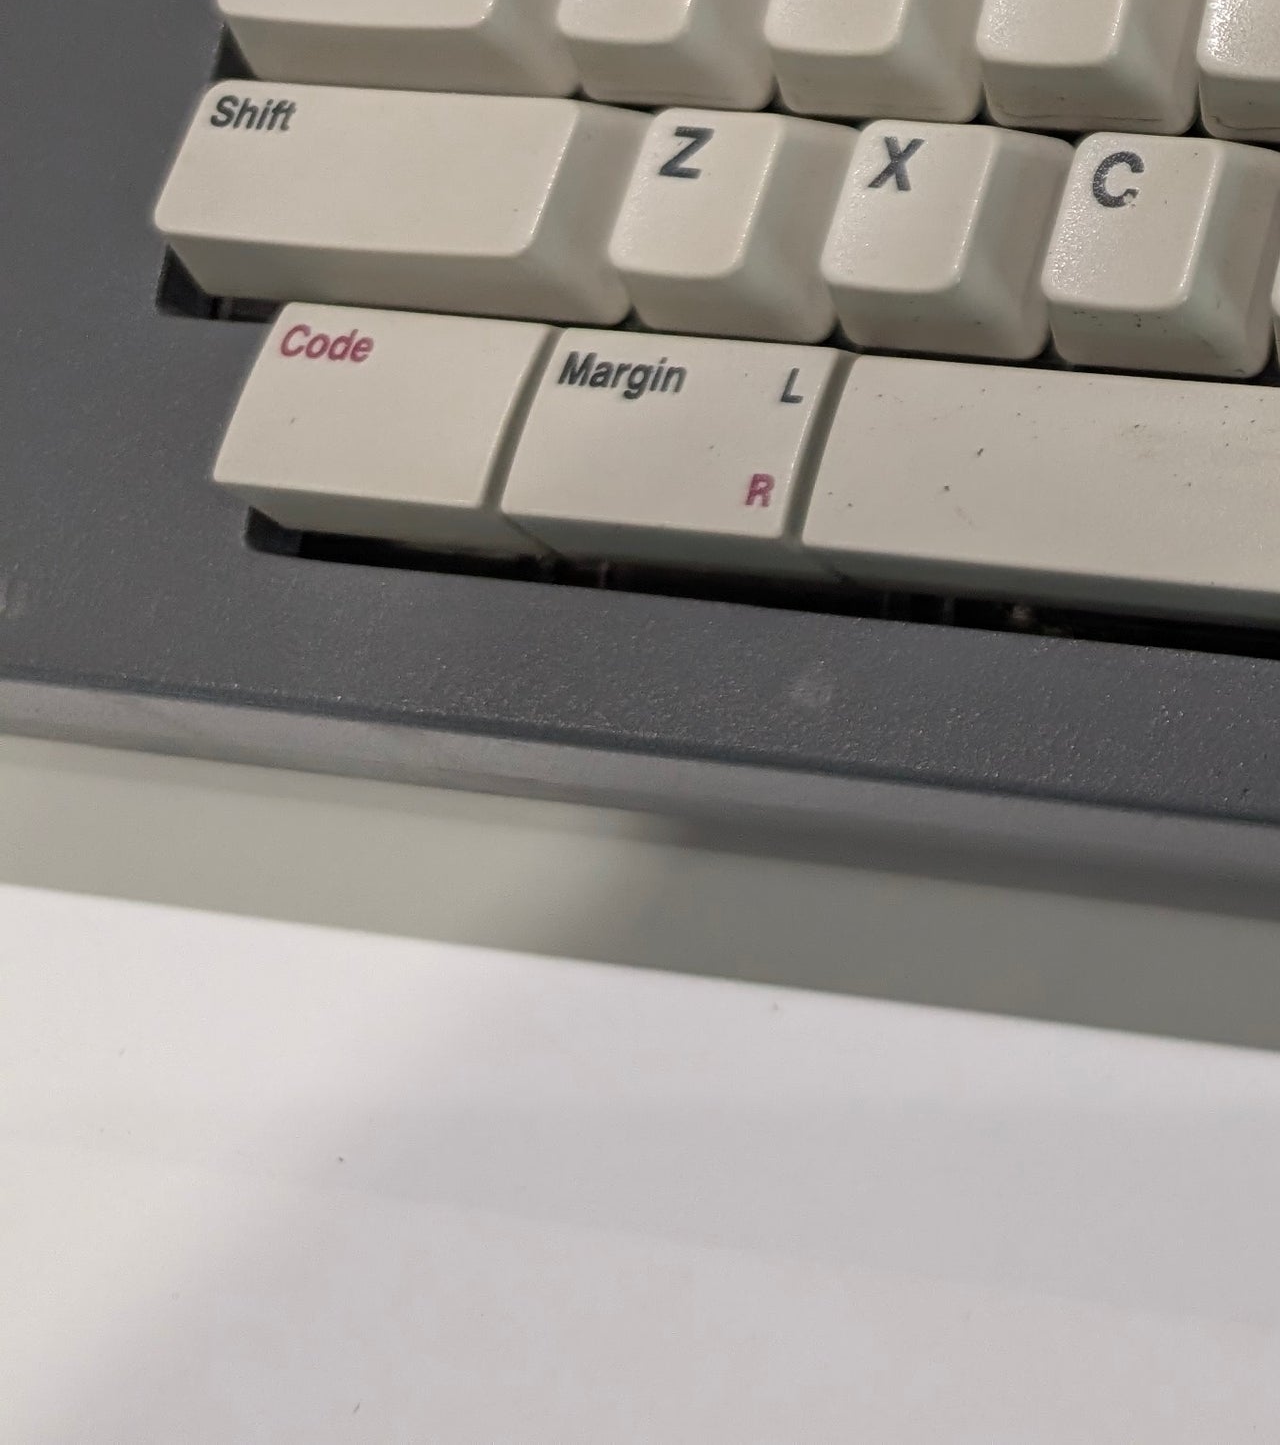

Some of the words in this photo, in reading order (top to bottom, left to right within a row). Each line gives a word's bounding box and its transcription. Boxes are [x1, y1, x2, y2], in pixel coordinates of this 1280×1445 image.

[209, 95, 295, 131] Shift
[658, 126, 712, 179] Z
[867, 137, 923, 192] X
[1092, 151, 1144, 209] C
[280, 324, 373, 363] Code
[557, 352, 685, 400] Margin
[779, 368, 803, 404] L
[745, 473, 774, 507] R
